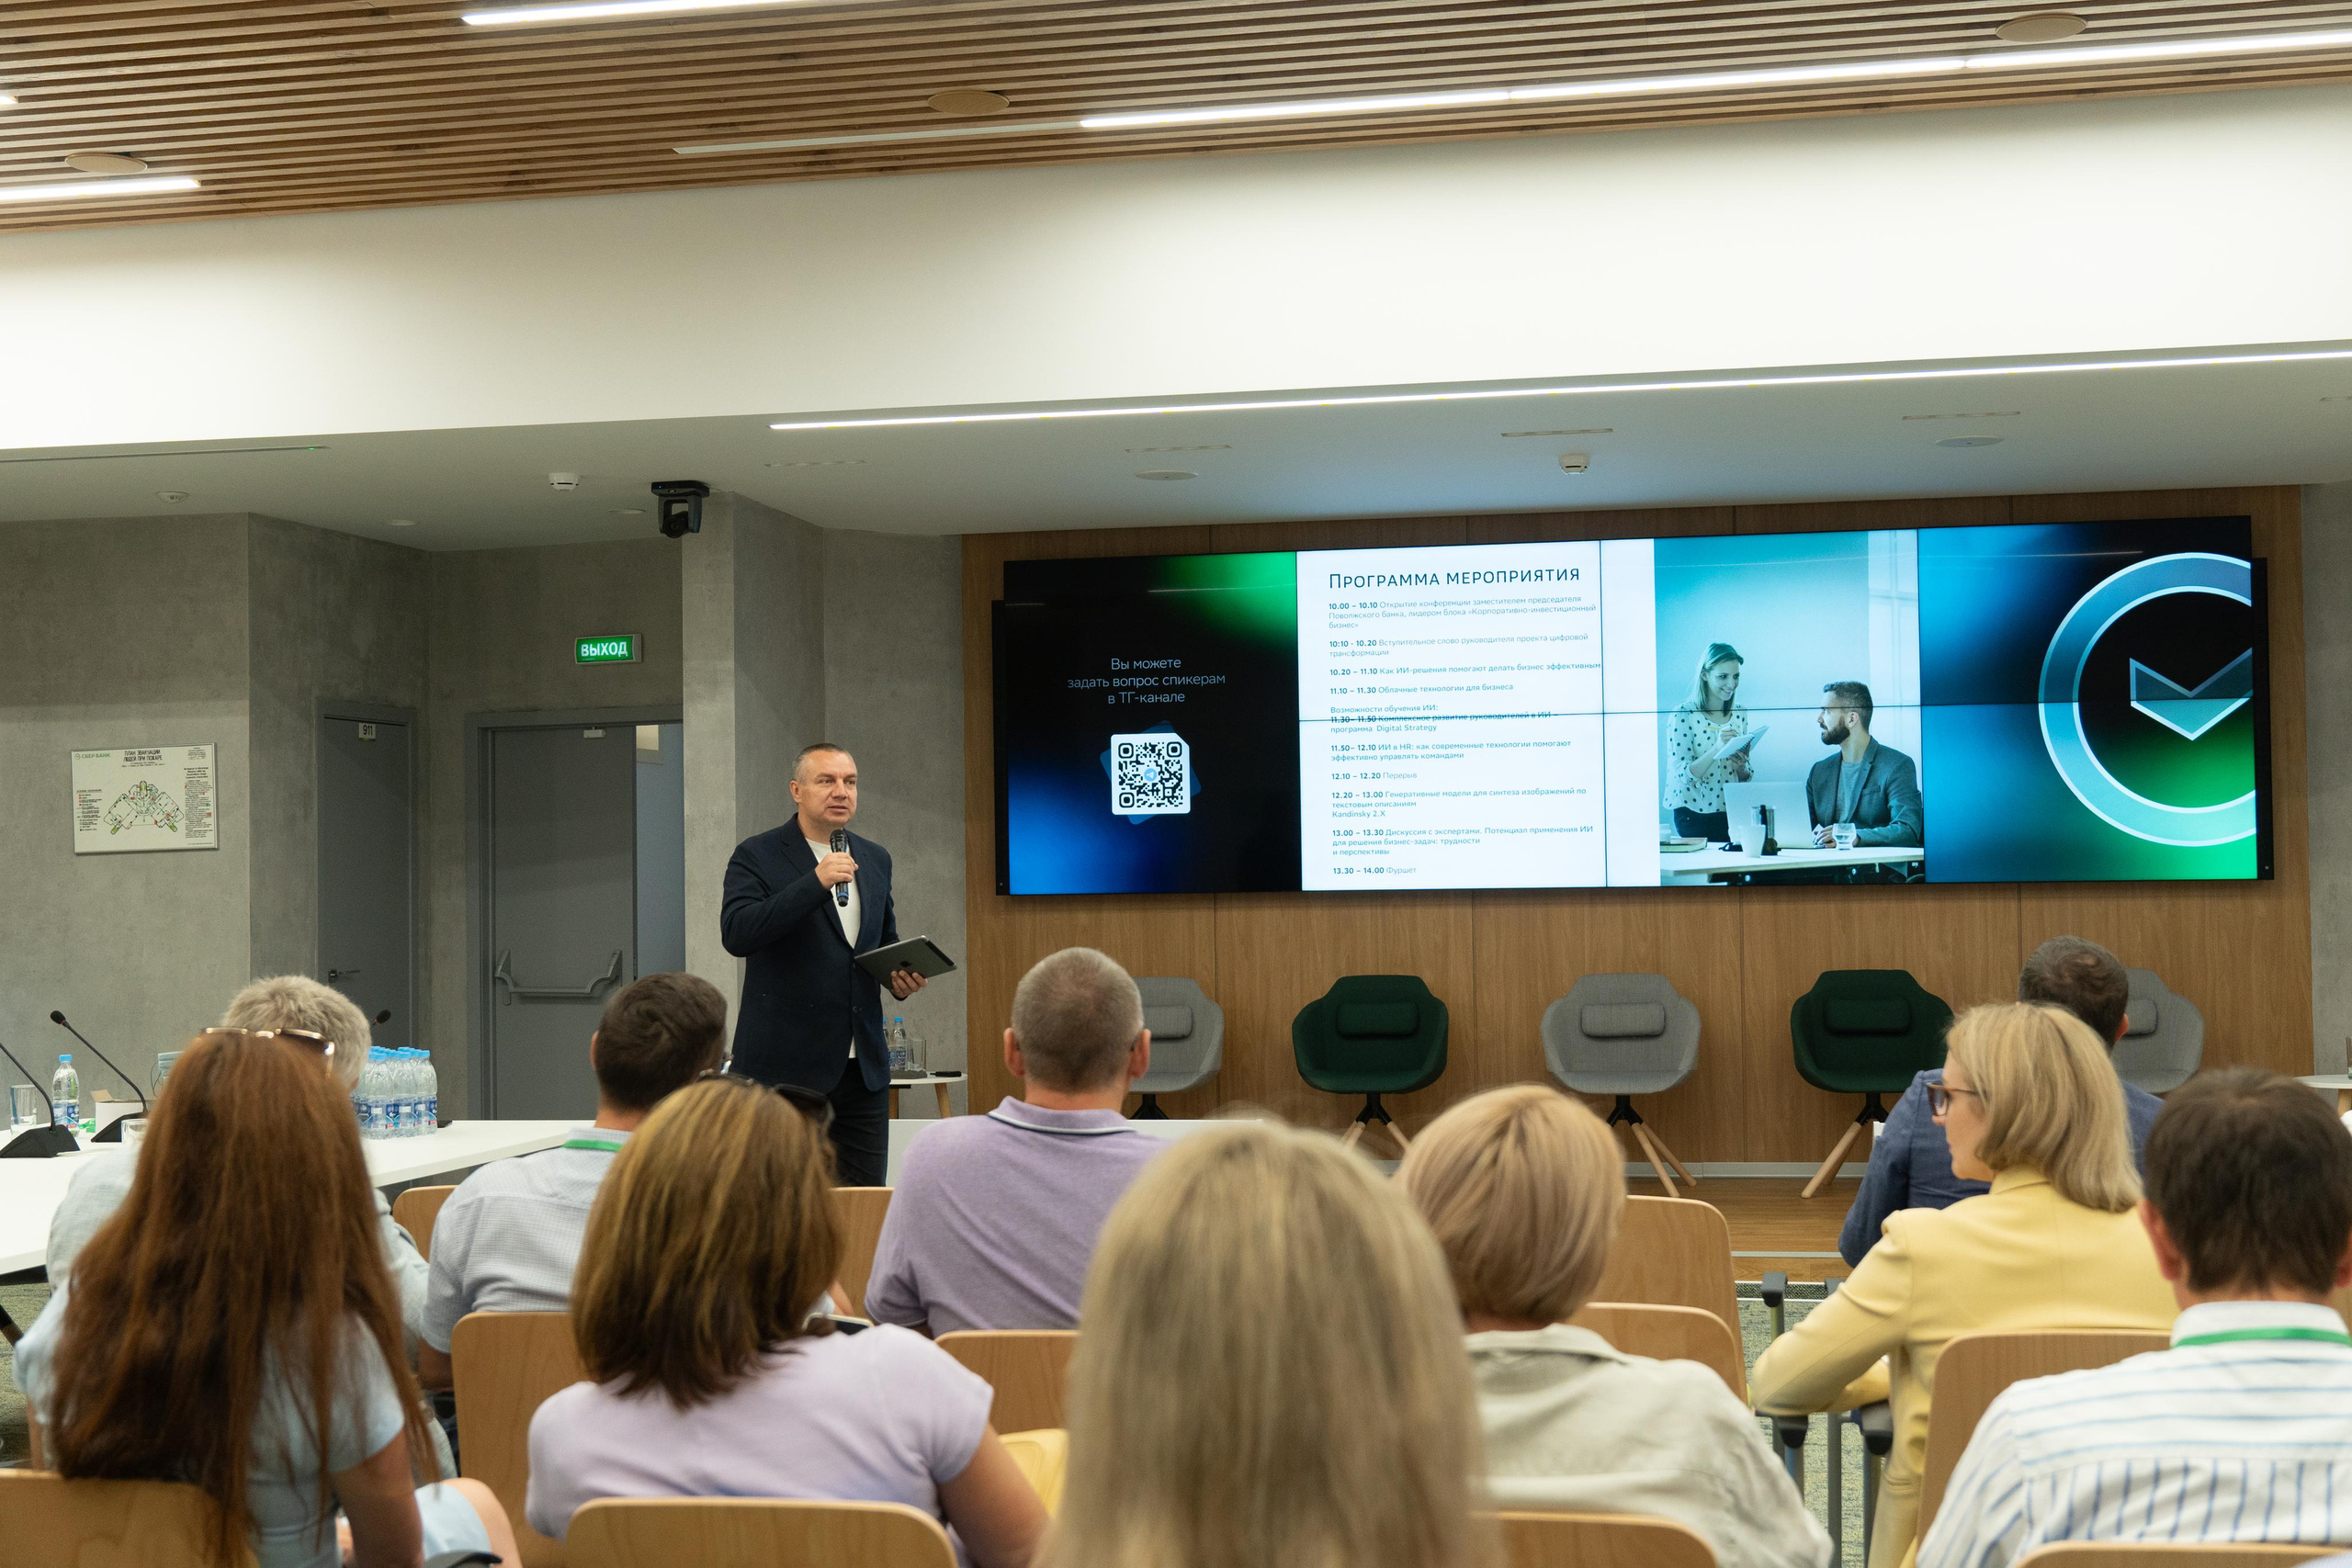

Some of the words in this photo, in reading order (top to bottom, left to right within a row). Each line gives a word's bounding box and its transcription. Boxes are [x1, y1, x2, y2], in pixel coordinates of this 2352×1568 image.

[1468, 604, 1596, 615] «Корпоративно-инвестиционный
[1461, 637, 1514, 645] руководителя
[581, 642, 628, 657] ВЫХОД
[1329, 649, 1389, 658] трансформации
[1111, 658, 1130, 670] Вы
[1133, 659, 1182, 670] можете
[1068, 677, 1109, 689] задать
[1113, 675, 1159, 689] вопрос
[1162, 674, 1226, 687] спикерам
[1108, 694, 1115, 704] в
[1118, 692, 1185, 704] ТГ-канале
[363, 725, 372, 735] 911
[1377, 725, 1402, 733] Digital
[1521, 788, 1575, 796] изображений
